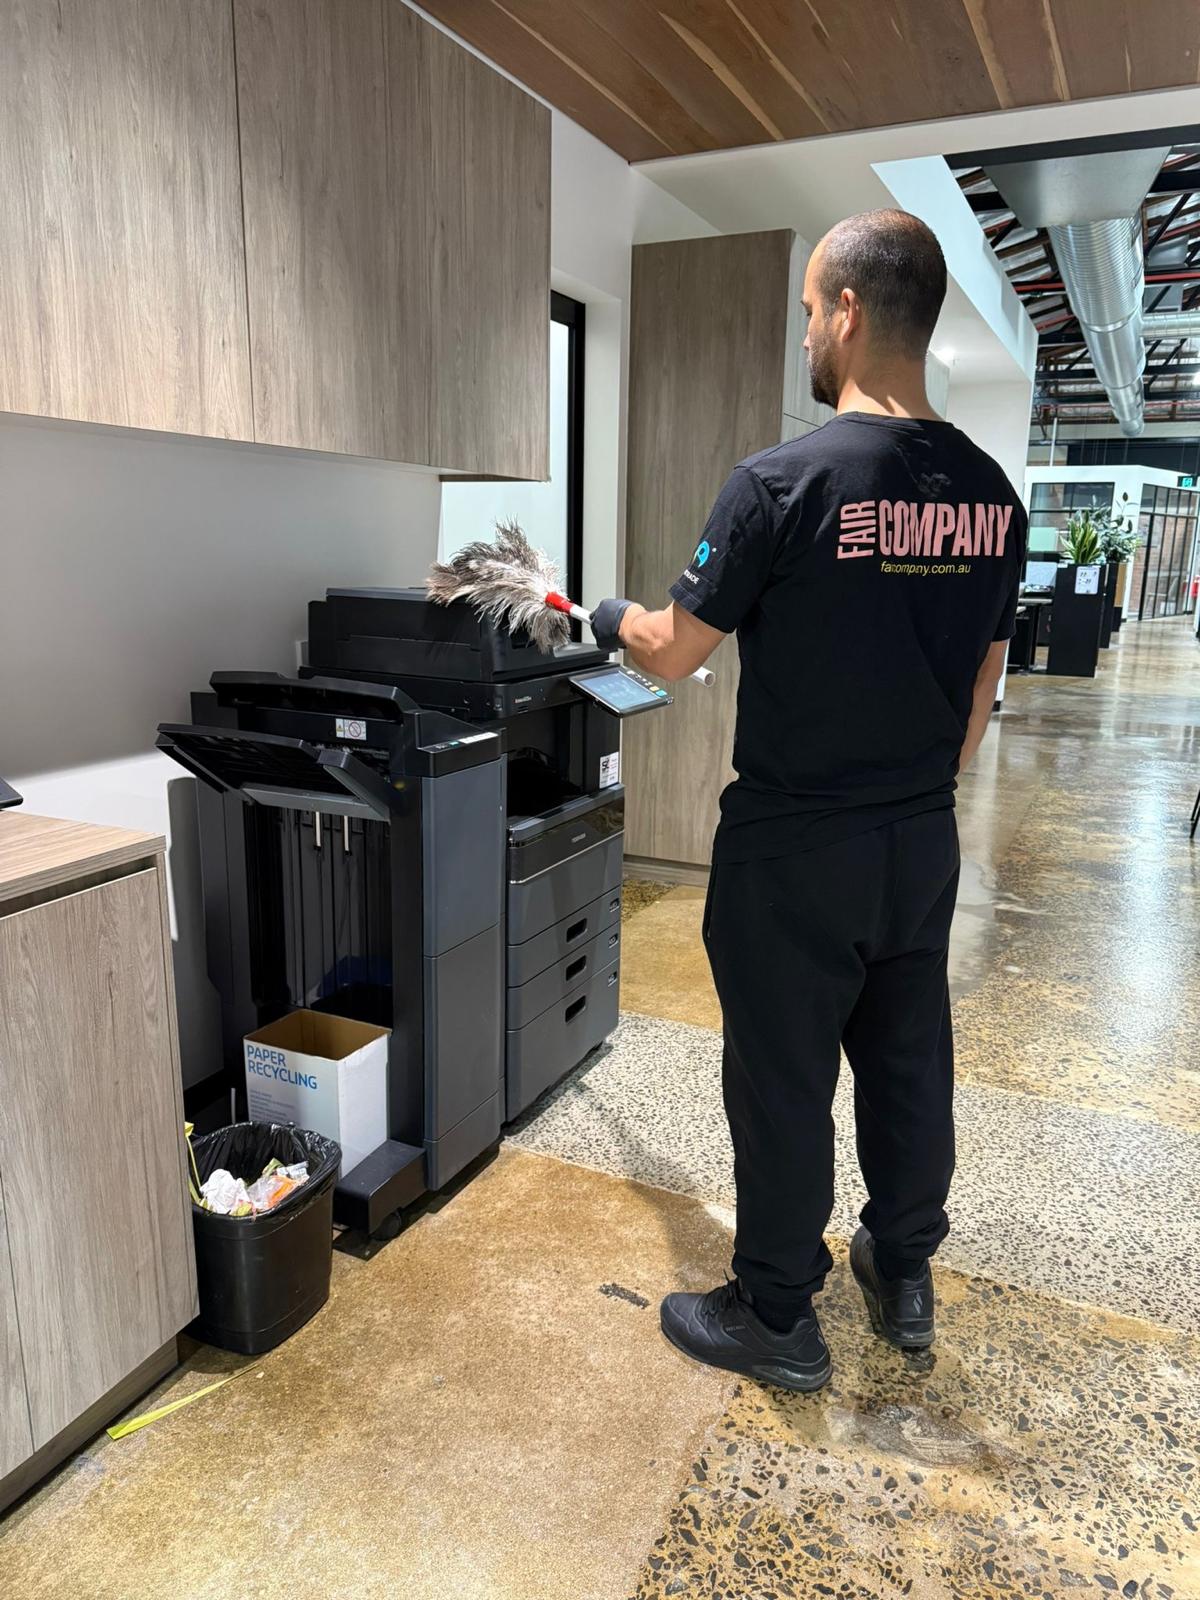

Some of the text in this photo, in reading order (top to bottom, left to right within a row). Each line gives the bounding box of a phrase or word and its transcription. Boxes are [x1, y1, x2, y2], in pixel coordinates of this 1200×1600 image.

[837, 499, 1013, 559] FAIR COMPANY
[247, 1045, 286, 1067] PAPER
[248, 1060, 317, 1090] RECYCLING
